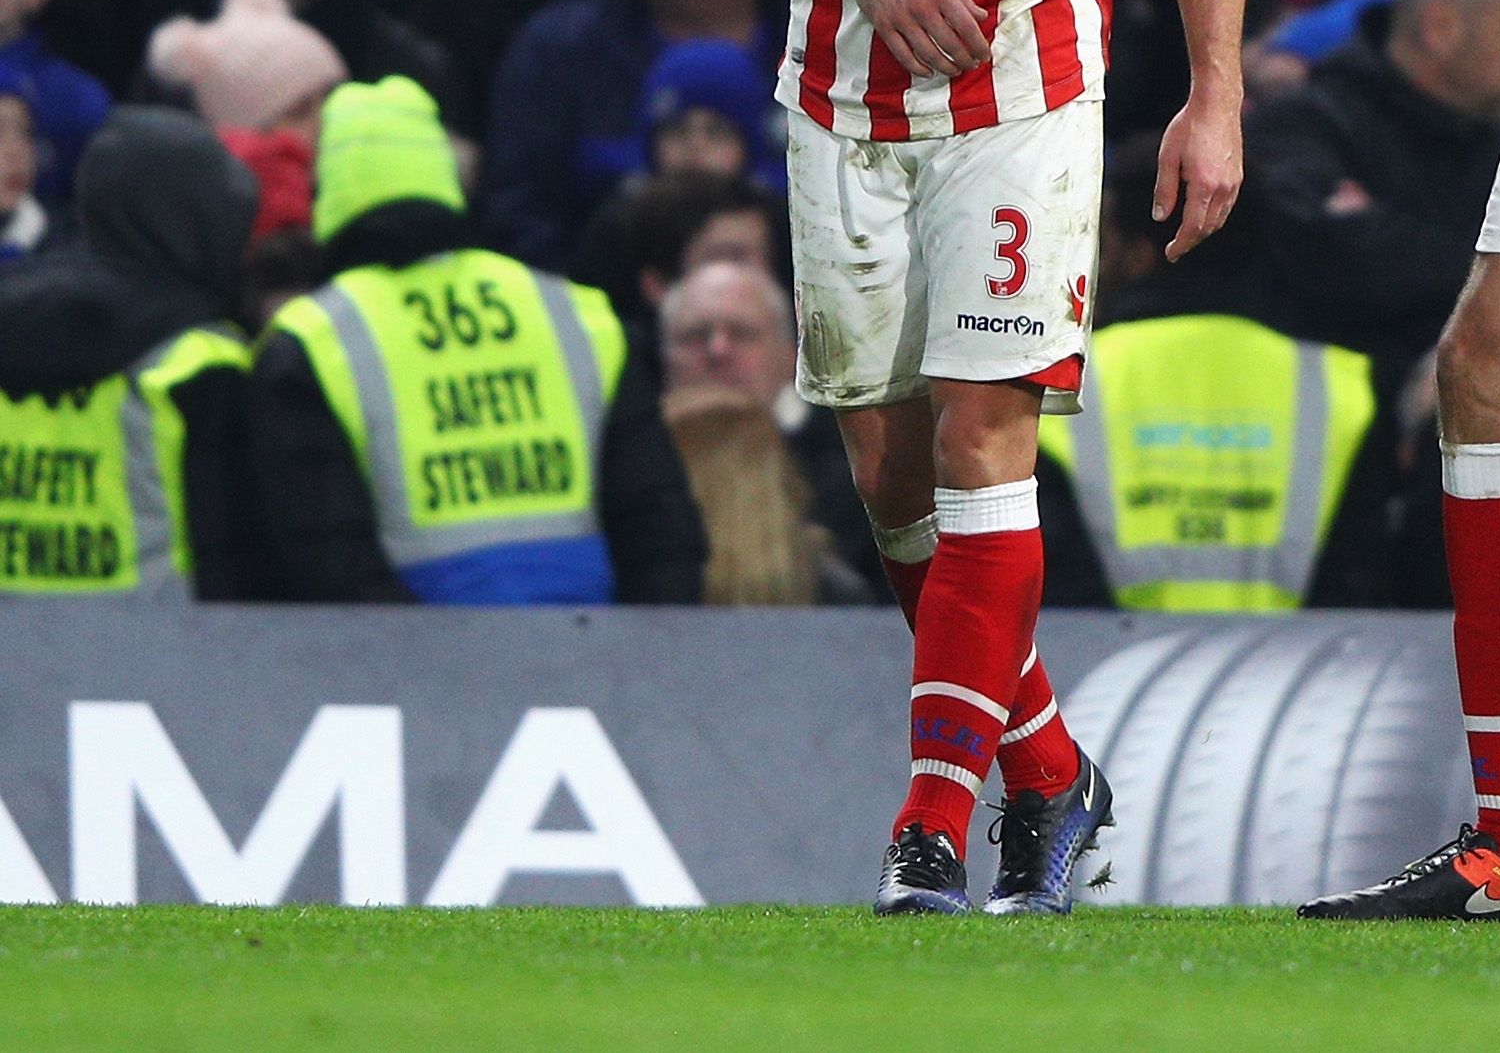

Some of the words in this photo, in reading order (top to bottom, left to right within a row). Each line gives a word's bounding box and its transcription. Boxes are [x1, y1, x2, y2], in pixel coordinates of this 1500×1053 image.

[984, 203, 1032, 299] 3
[404, 278, 517, 352] 365
[956, 311, 1045, 338] macron
[427, 365, 543, 433] SAFETY
[421, 436, 574, 511] STEWARD
